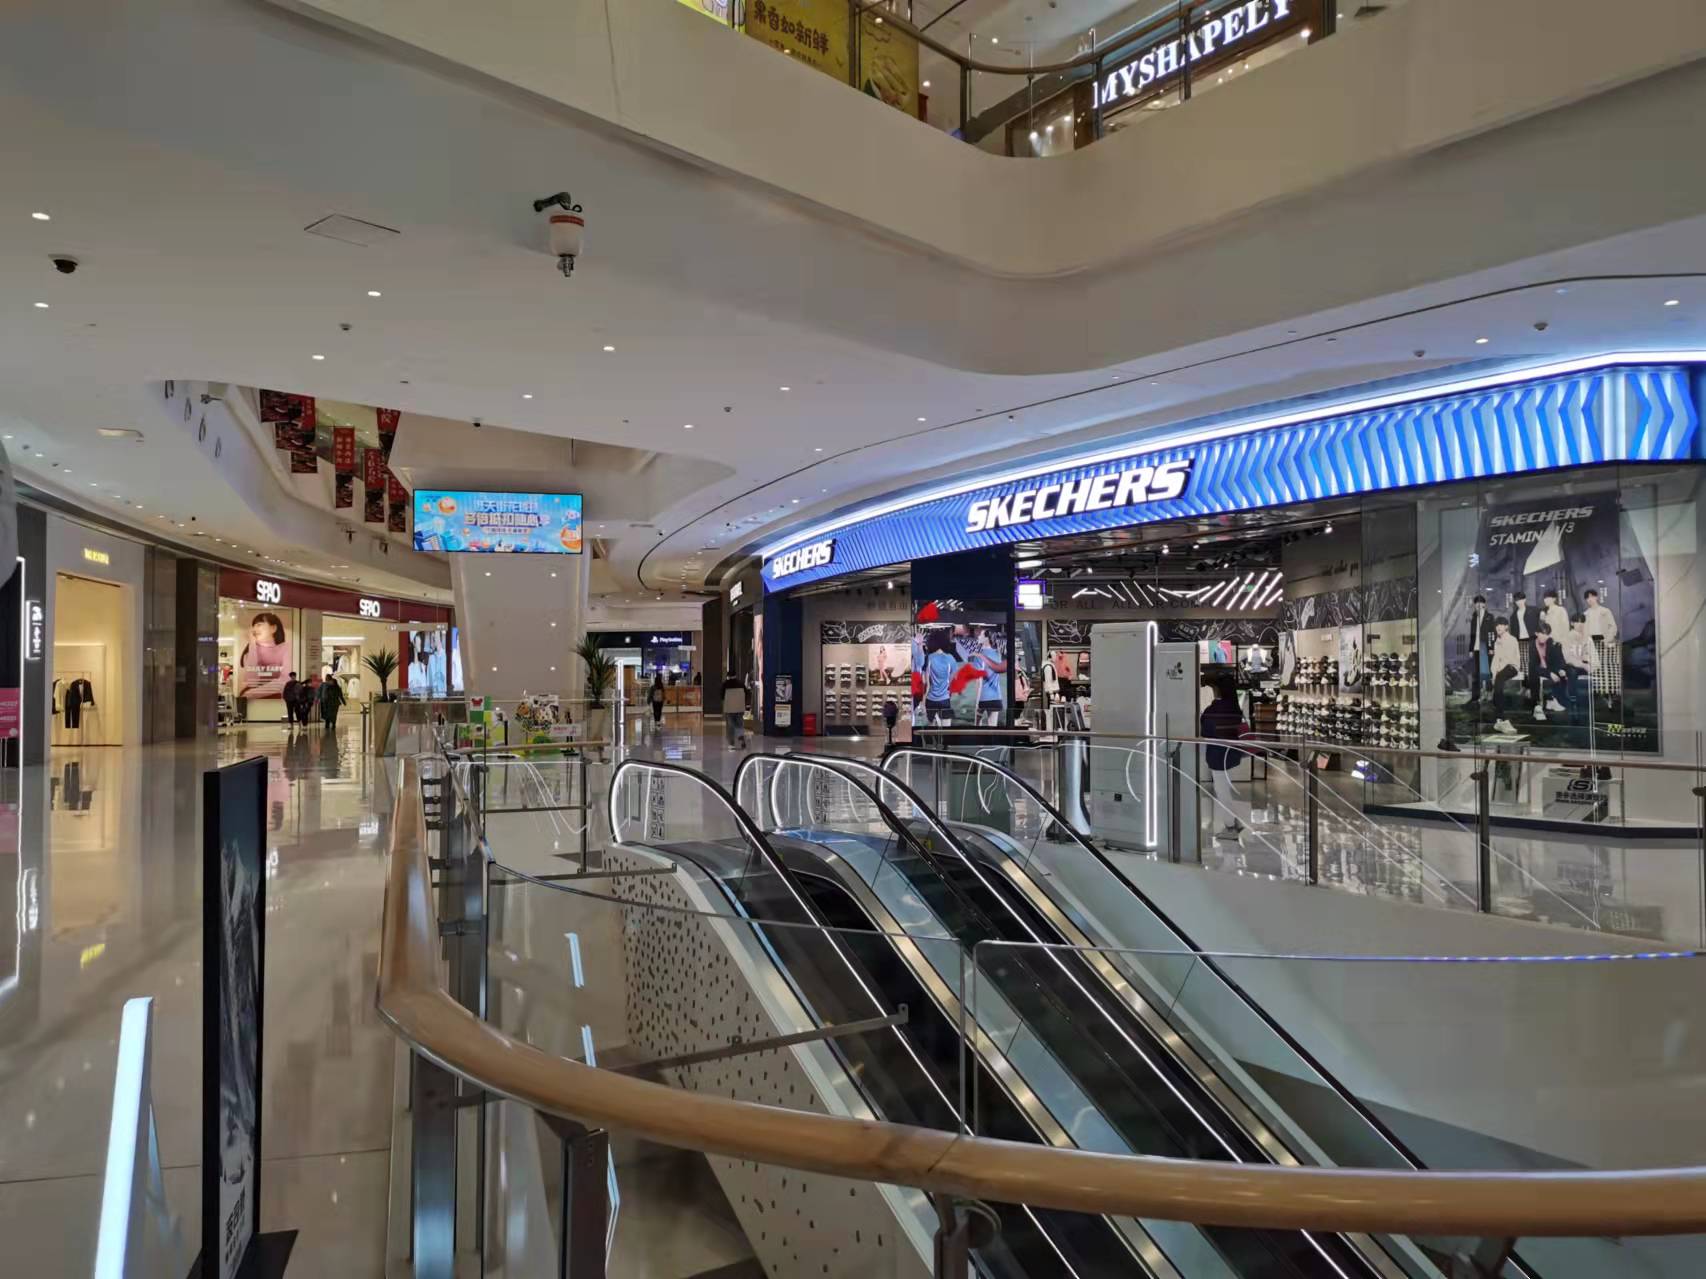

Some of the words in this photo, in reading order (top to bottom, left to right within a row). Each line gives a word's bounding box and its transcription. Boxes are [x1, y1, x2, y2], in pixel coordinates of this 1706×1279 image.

[1092, 0, 1290, 109] MYSHAPELY
[965, 459, 1190, 533] SKECHERS
[1489, 506, 1595, 527] SKECHERS
[772, 539, 834, 579] SKECHERS
[256, 580, 281, 603] SPAO
[359, 598, 381, 617] SPAO
